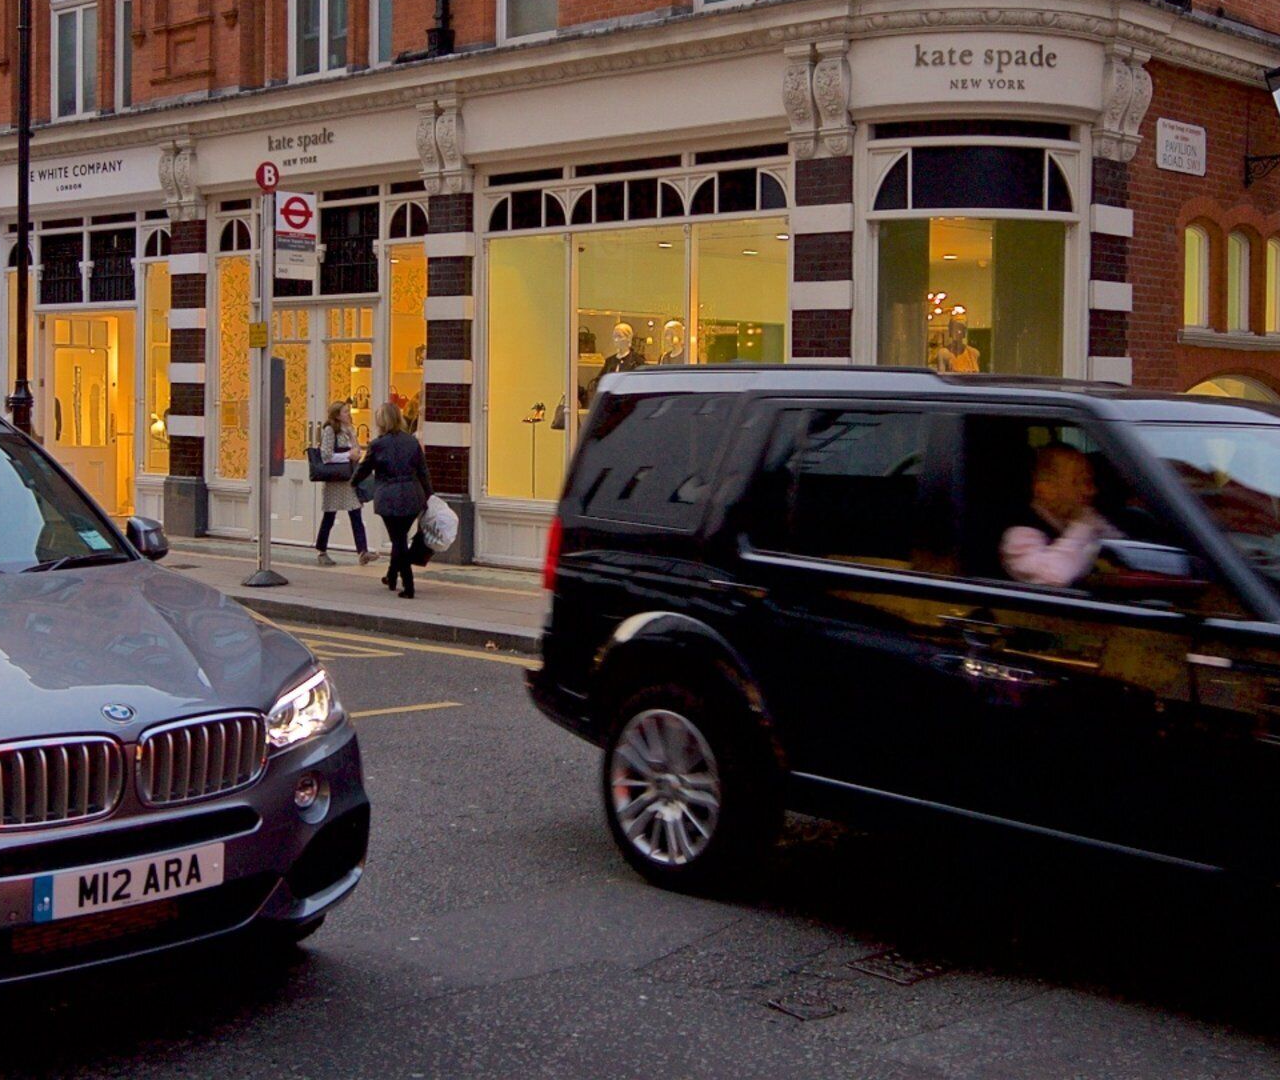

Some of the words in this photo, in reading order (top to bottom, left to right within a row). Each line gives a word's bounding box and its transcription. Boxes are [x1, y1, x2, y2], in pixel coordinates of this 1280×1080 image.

[914, 44, 974, 67] kate
[983, 43, 1058, 73] spade
[949, 78, 982, 90] NEW
[987, 78, 1026, 90] YORK
[267, 134, 294, 152] kate
[296, 127, 335, 152] spade
[37, 166, 69, 182] WHITE
[72, 159, 124, 178] COMPANY
[282, 157, 298, 167] NEW
[299, 155, 318, 166] YORK
[263, 165, 276, 186] B
[55, 182, 82, 192] LONDON
[78, 868, 132, 908] M12
[142, 853, 203, 897] ARA
